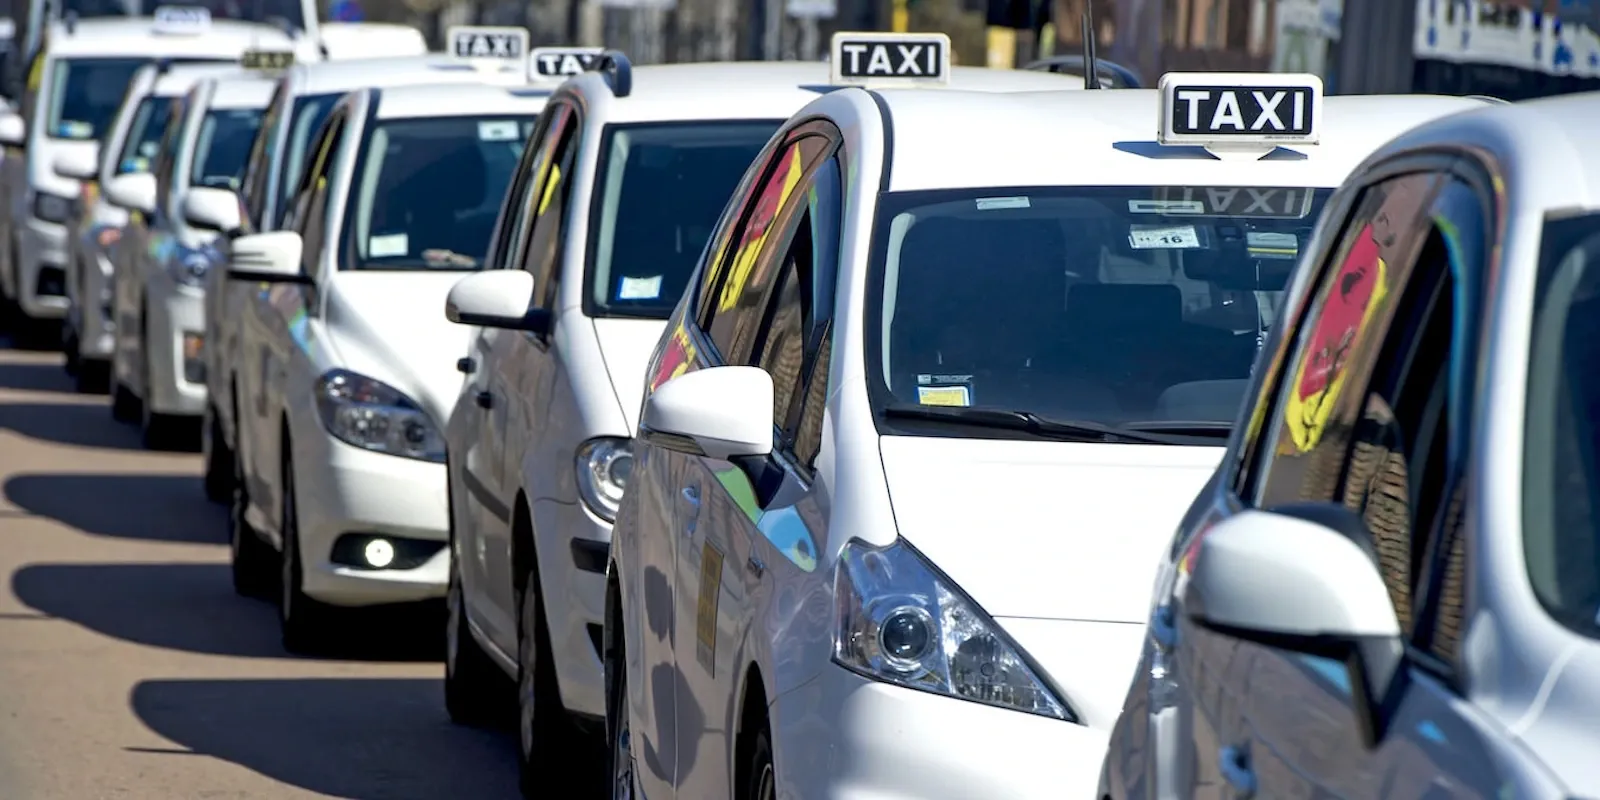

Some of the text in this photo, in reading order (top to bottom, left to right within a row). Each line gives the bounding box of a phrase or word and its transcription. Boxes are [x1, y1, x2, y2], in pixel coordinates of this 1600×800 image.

[457, 35, 520, 57] TAXI
[540, 55, 592, 75] TA
[844, 45, 936, 74] TAXI
[1178, 91, 1304, 130] TAXI
[1160, 236, 1182, 244] 16
